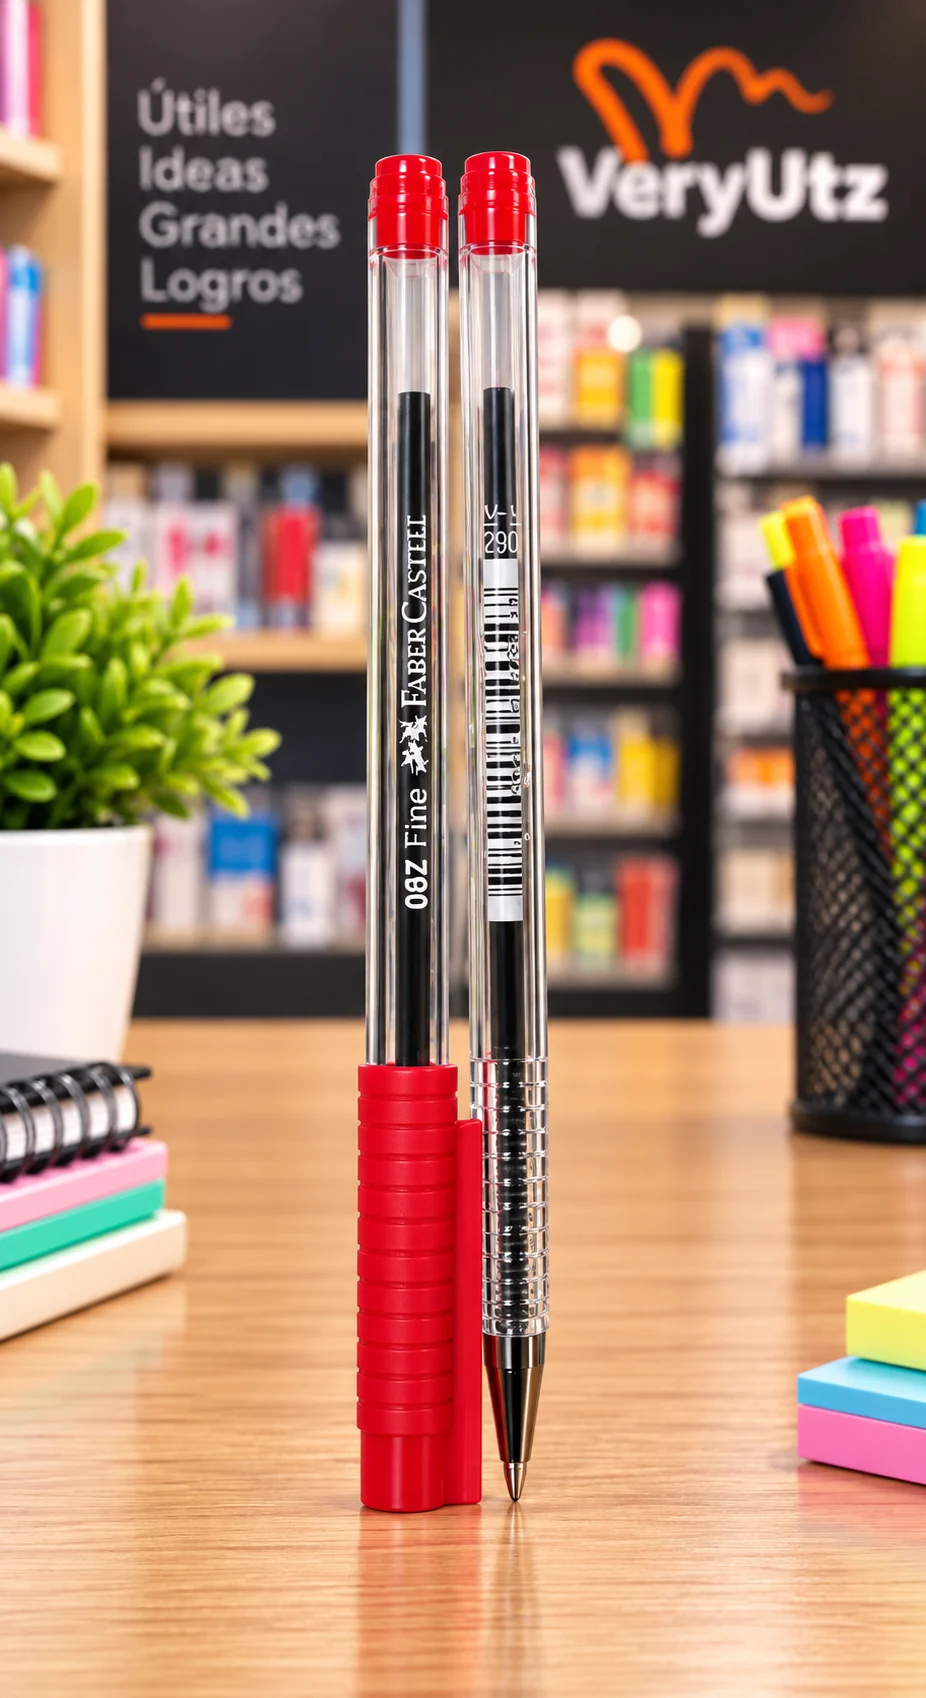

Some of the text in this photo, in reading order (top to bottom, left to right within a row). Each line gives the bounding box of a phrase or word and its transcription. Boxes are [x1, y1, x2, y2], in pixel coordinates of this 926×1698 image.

[137, 76, 276, 136] Útiles
[139, 145, 269, 192] Ideas
[556, 146, 888, 238] VeryUtz
[138, 200, 341, 249] Grandes
[141, 255, 303, 313] Logros
[401, 628, 427, 707] FABER
[404, 788, 427, 848] Fine
